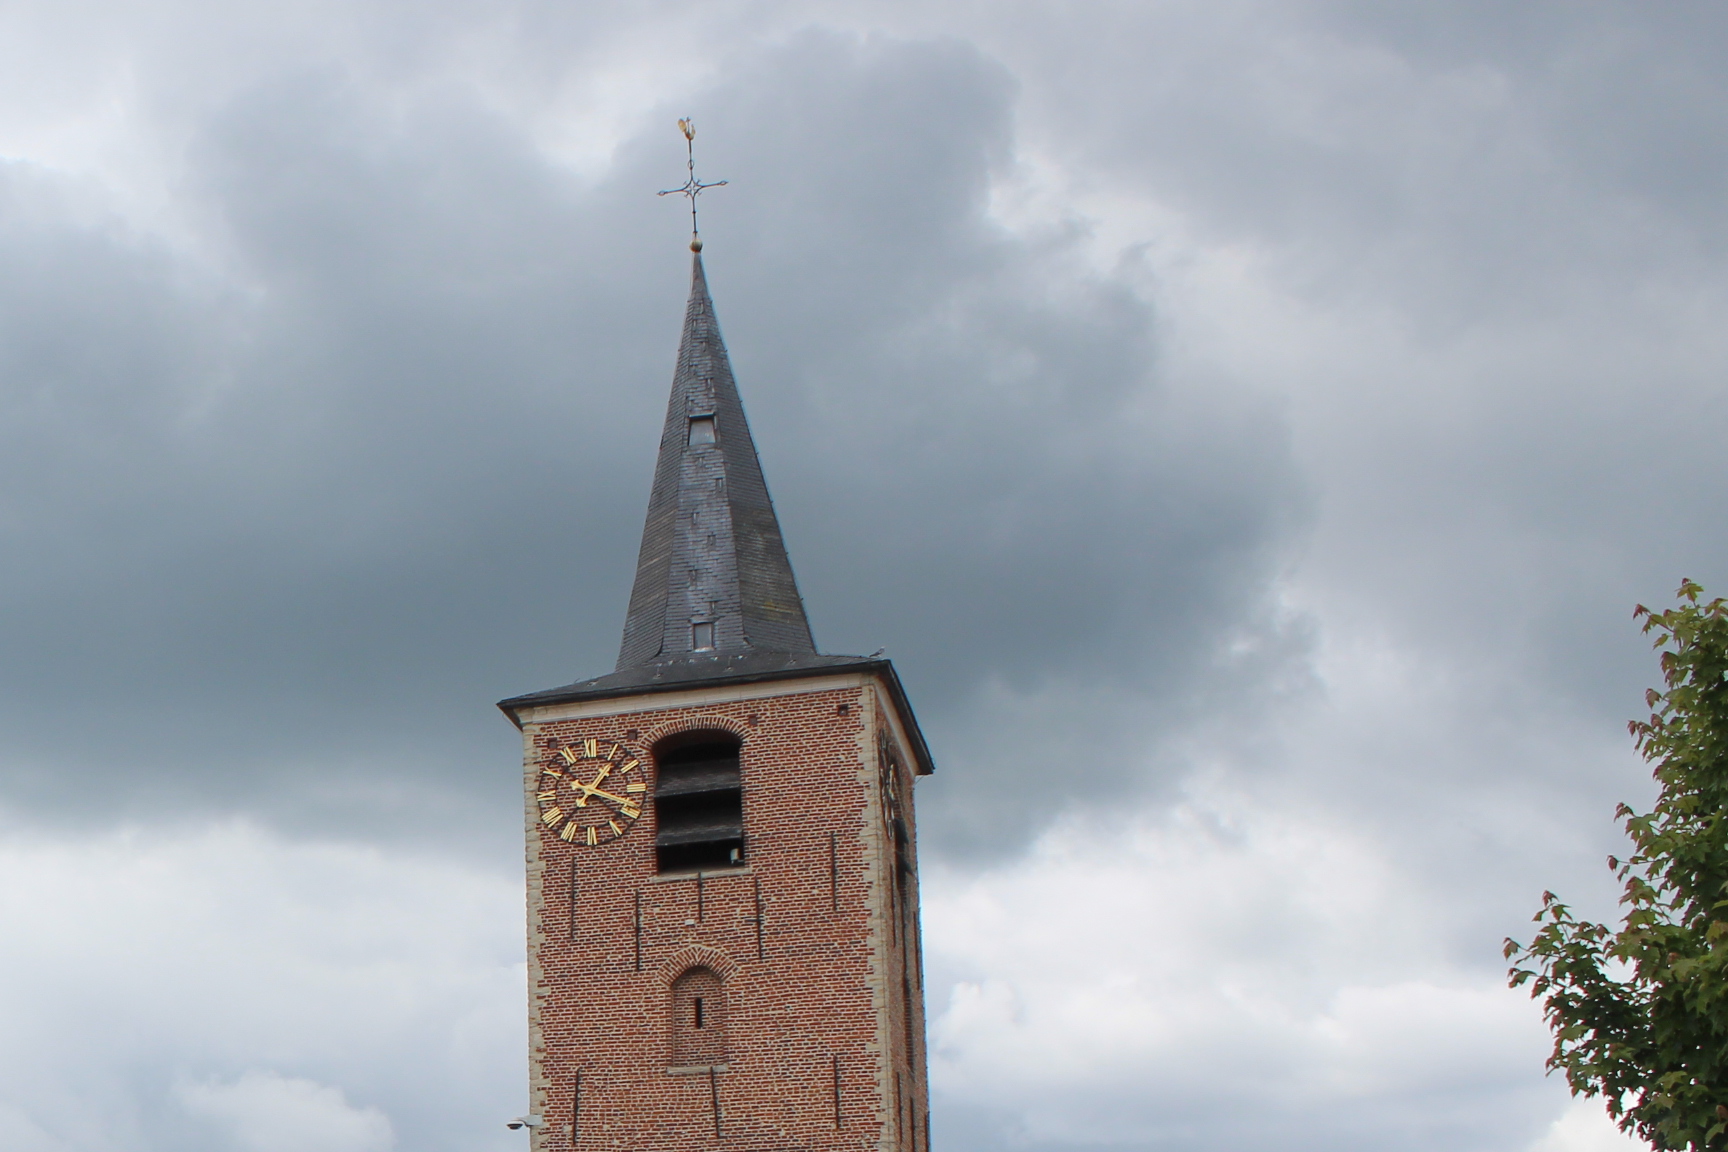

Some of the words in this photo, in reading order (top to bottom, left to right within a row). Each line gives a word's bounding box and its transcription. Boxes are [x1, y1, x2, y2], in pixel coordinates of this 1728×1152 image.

[559, 746, 577, 766] XI
[583, 739, 597, 758] XII
[607, 743, 619, 761] I
[620, 759, 639, 774] II
[626, 783, 647, 793] III
